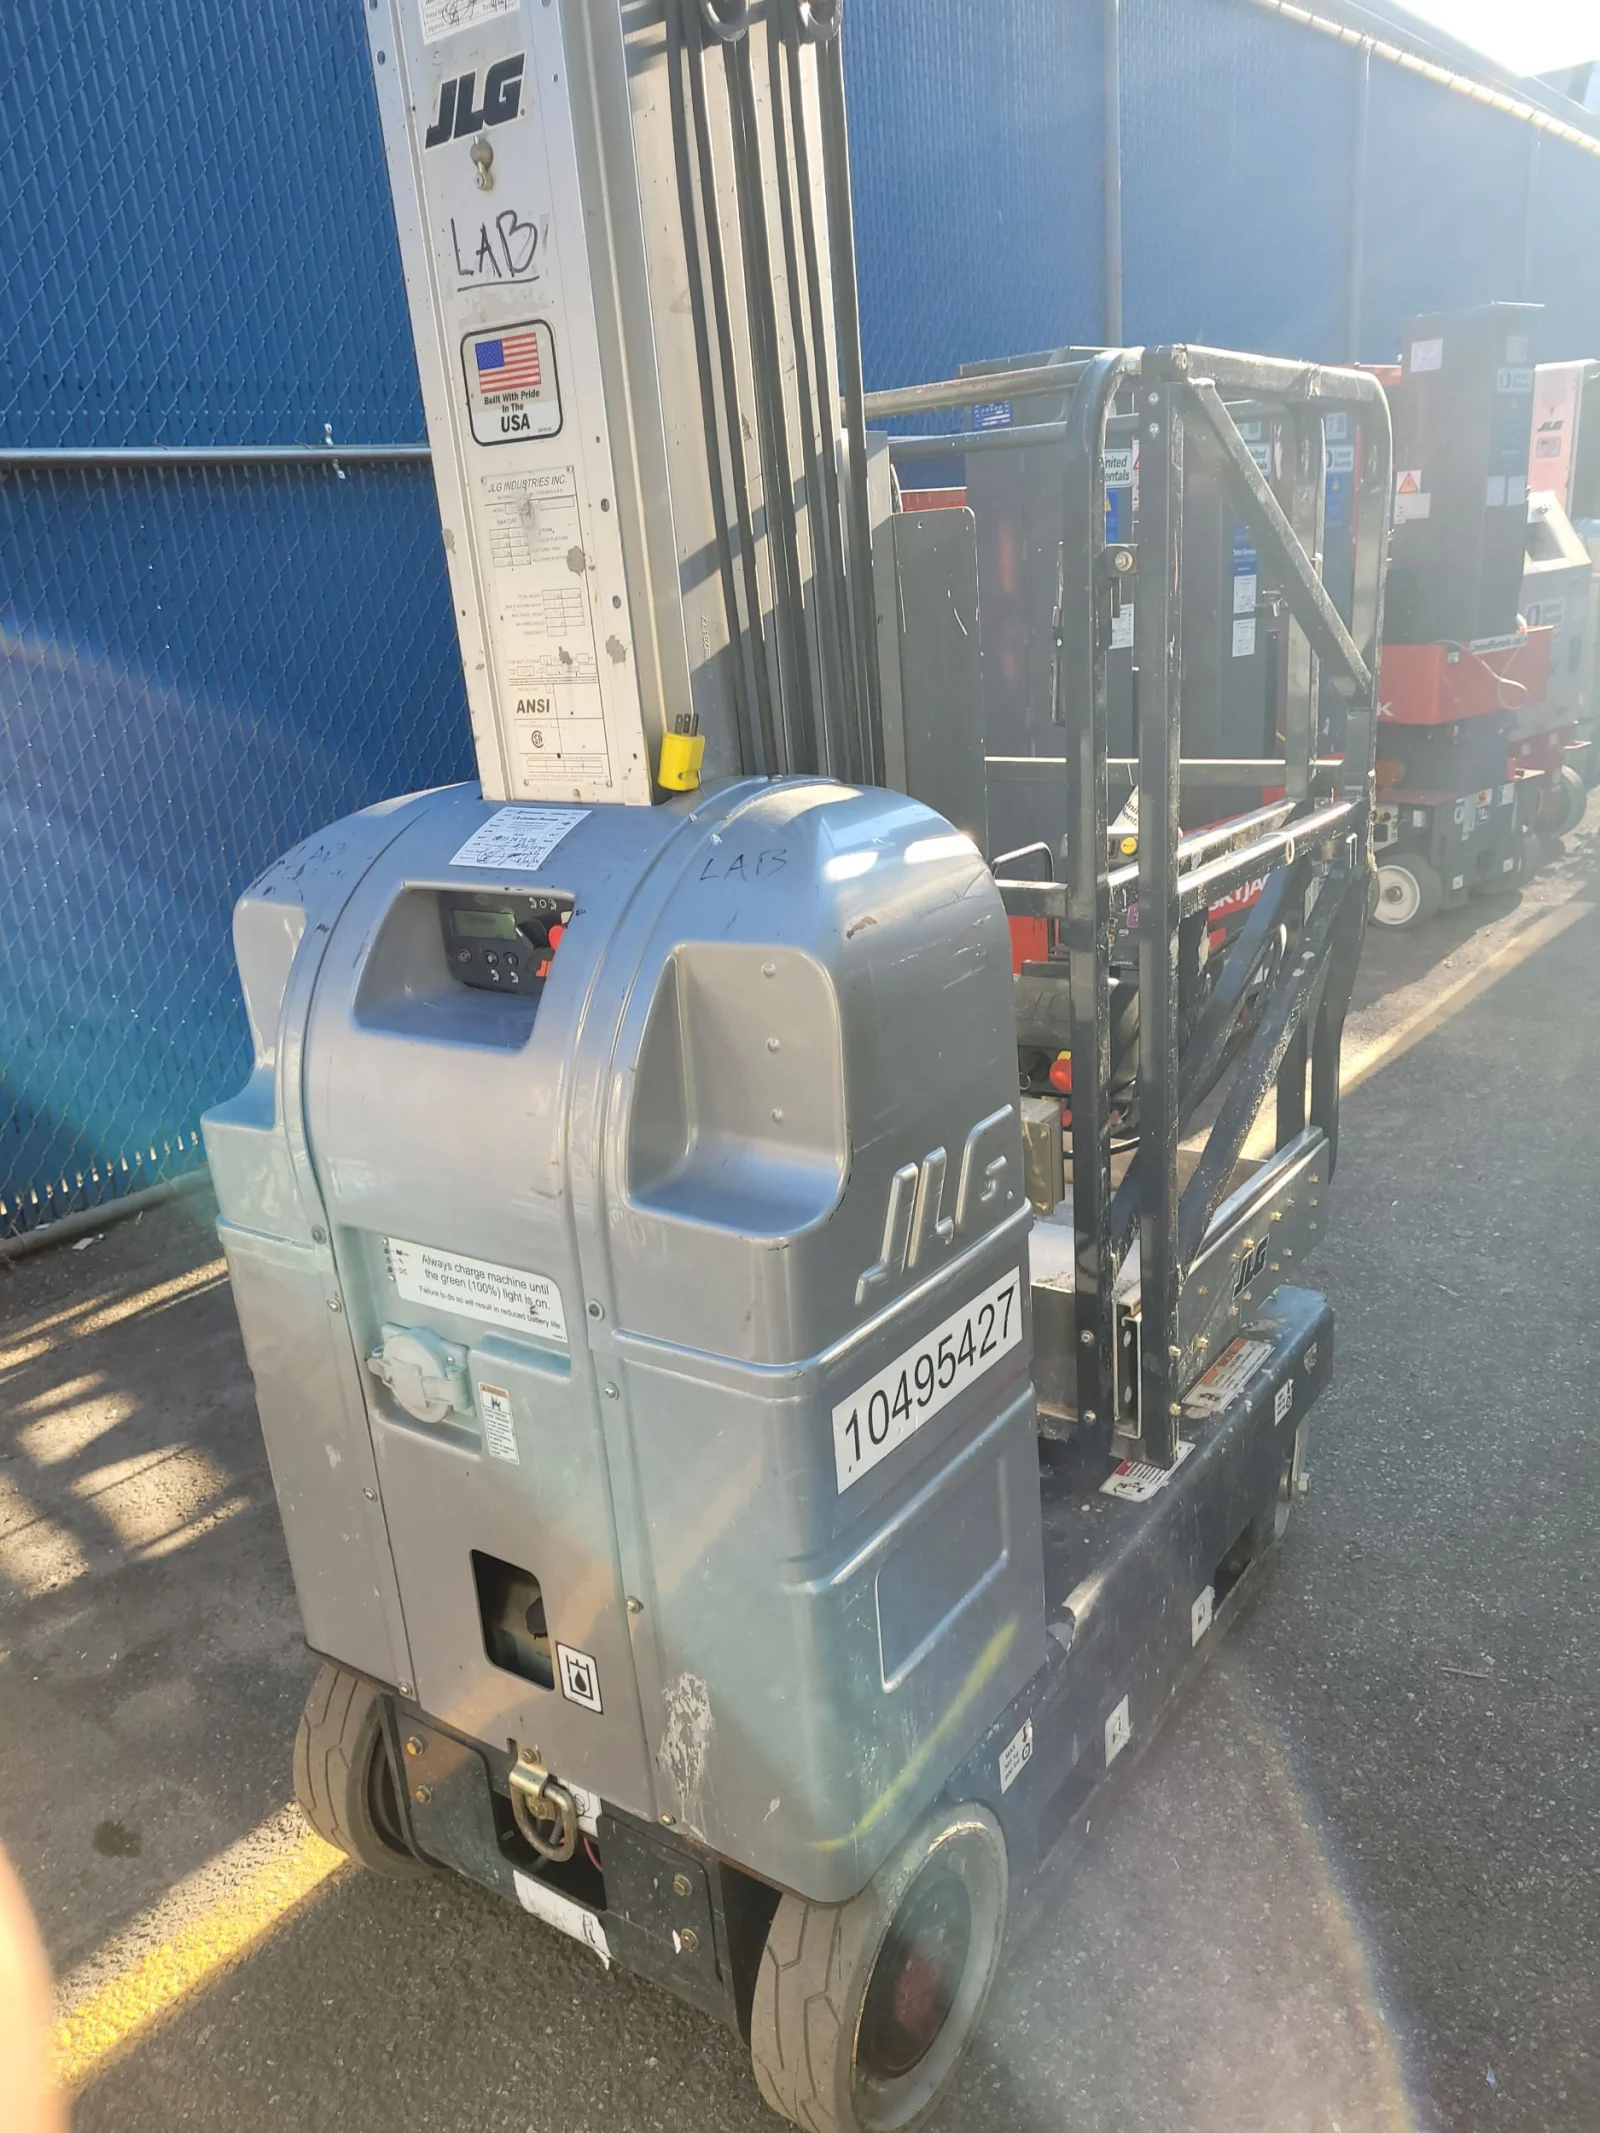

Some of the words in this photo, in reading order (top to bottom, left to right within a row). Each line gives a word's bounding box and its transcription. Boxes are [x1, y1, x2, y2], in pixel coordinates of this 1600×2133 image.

[425, 53, 525, 149] JLG
[451, 210, 538, 278] LAB
[484, 395, 500, 405] Built
[502, 392, 519, 402] With
[521, 389, 540, 399] Pride
[502, 404, 509, 413] In
[511, 403, 524, 412] The
[501, 413, 530, 433] USA
[1105, 455, 1127, 468] nited
[1105, 469, 1130, 481] entals
[488, 482, 502, 493] JLG
[503, 477, 550, 492] INDUSTRIES
[551, 474, 566, 485] INC.
[516, 698, 550, 714] ANSI
[700, 849, 787, 881] LAB
[855, 1103, 1013, 1305] JLG
[421, 1254, 453, 1272] Always
[454, 1263, 486, 1280] charge
[487, 1272, 527, 1290] machine
[529, 1282, 549, 1296] until
[1234, 1235, 1269, 1299] JLG
[419, 1285, 440, 1298] Failure
[440, 1291, 446, 1299] to
[447, 1293, 455, 1302] do
[455, 1296, 464, 1304] so
[464, 1297, 475, 1307] will
[475, 1301, 492, 1311] result
[493, 1305, 500, 1313] in
[500, 1308, 526, 1321] reduced
[526, 1314, 550, 1328] battery
[550, 1320, 562, 1330] life.
[425, 1269, 439, 1281] the
[440, 1275, 466, 1289] green
[468, 1280, 501, 1300] (100%)
[502, 1289, 523, 1305] light
[525, 1294, 533, 1306] is
[535, 1299, 551, 1311] on.
[845, 1286, 1015, 1463] 10495427
